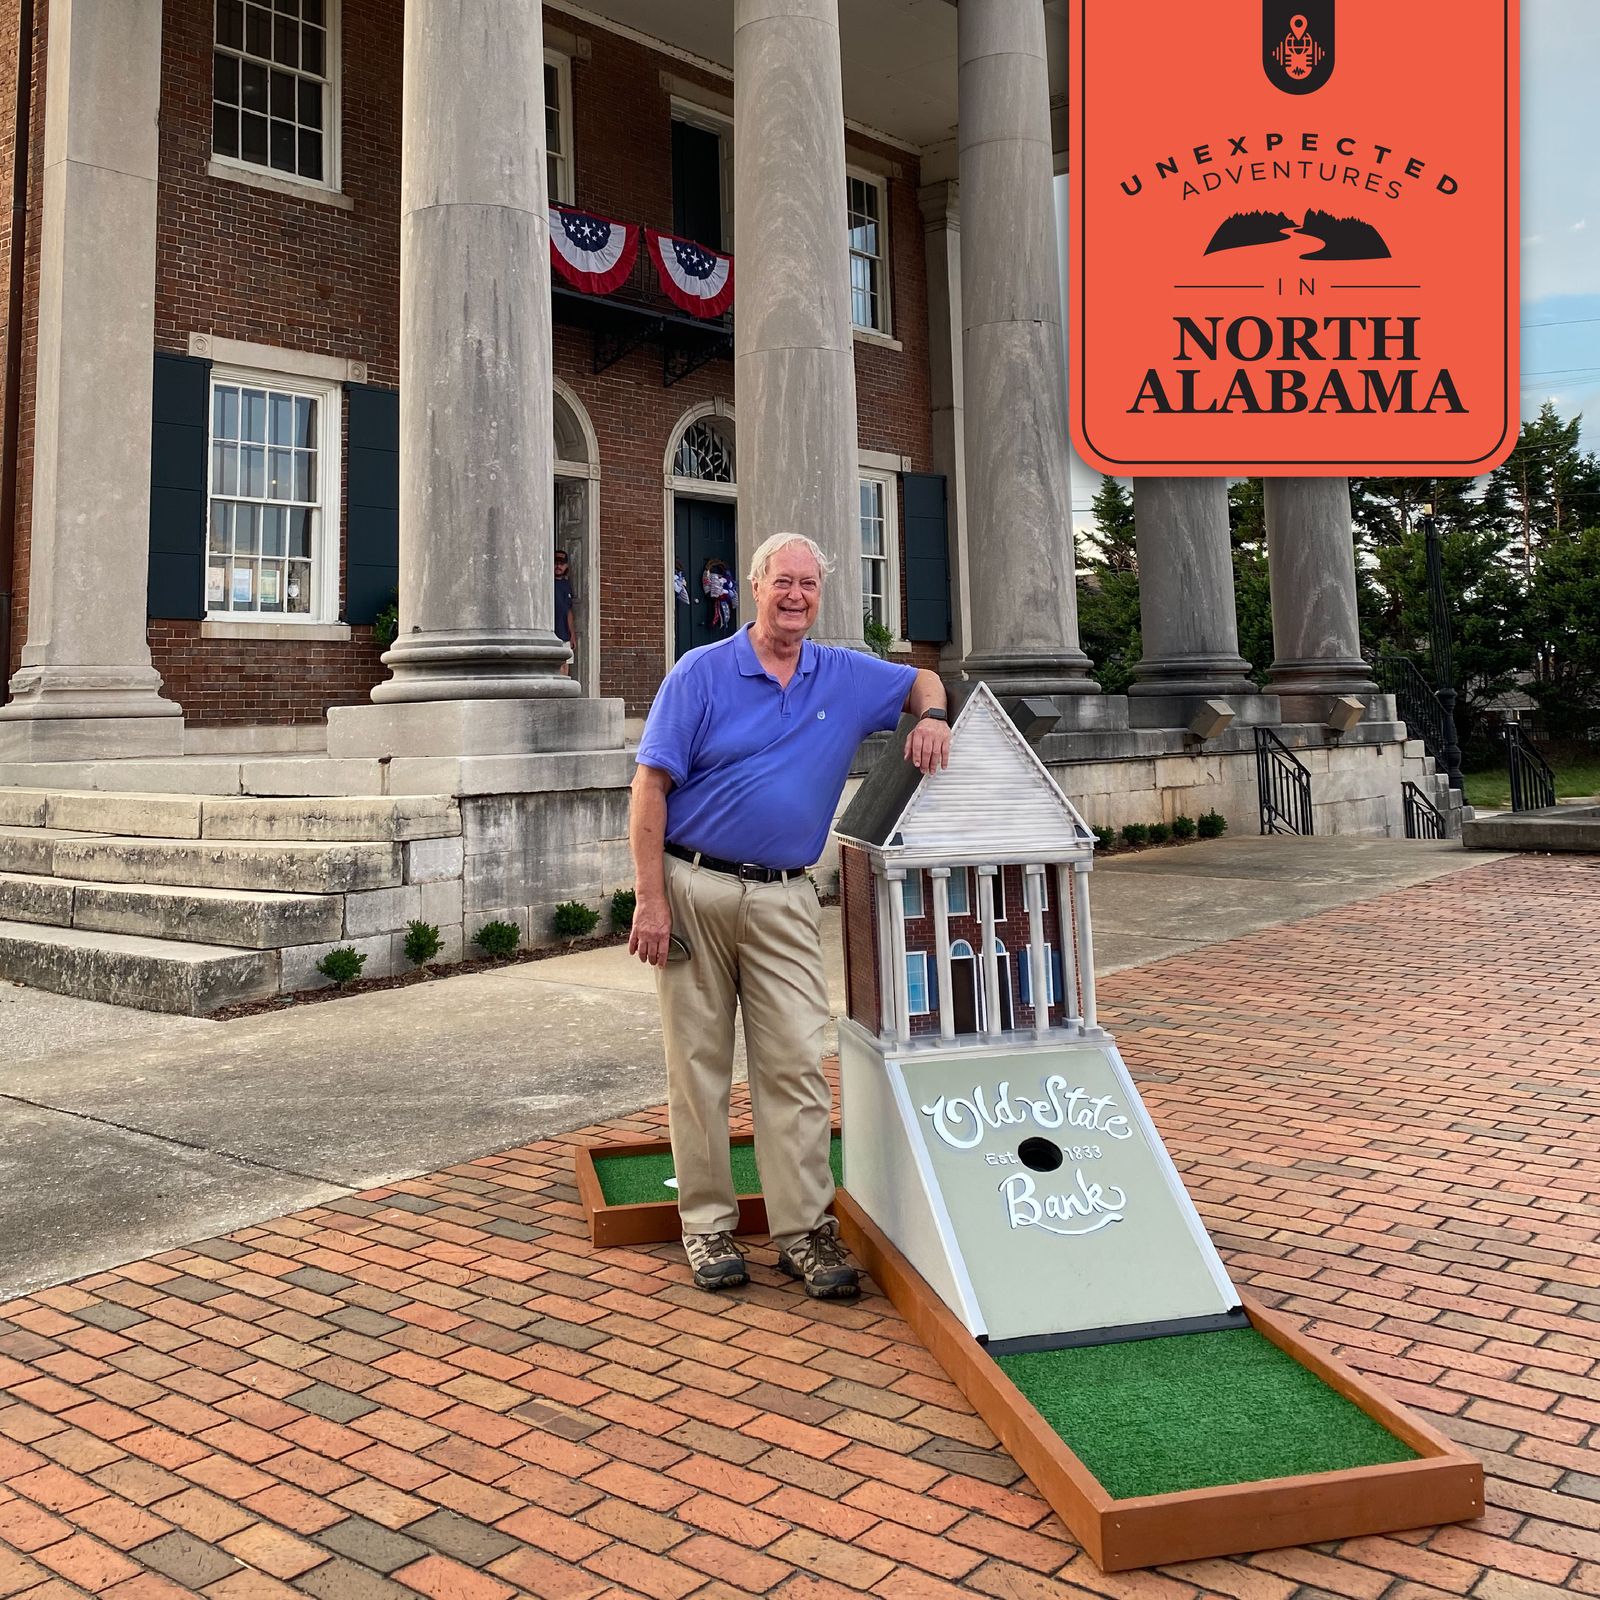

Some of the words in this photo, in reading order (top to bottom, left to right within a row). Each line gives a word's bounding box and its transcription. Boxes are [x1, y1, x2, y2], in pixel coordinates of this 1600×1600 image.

[921, 1081, 1027, 1149] Old
[1016, 1075, 1133, 1139] State
[1063, 1145, 1102, 1162] 1833
[998, 1168, 1127, 1235] Bank
